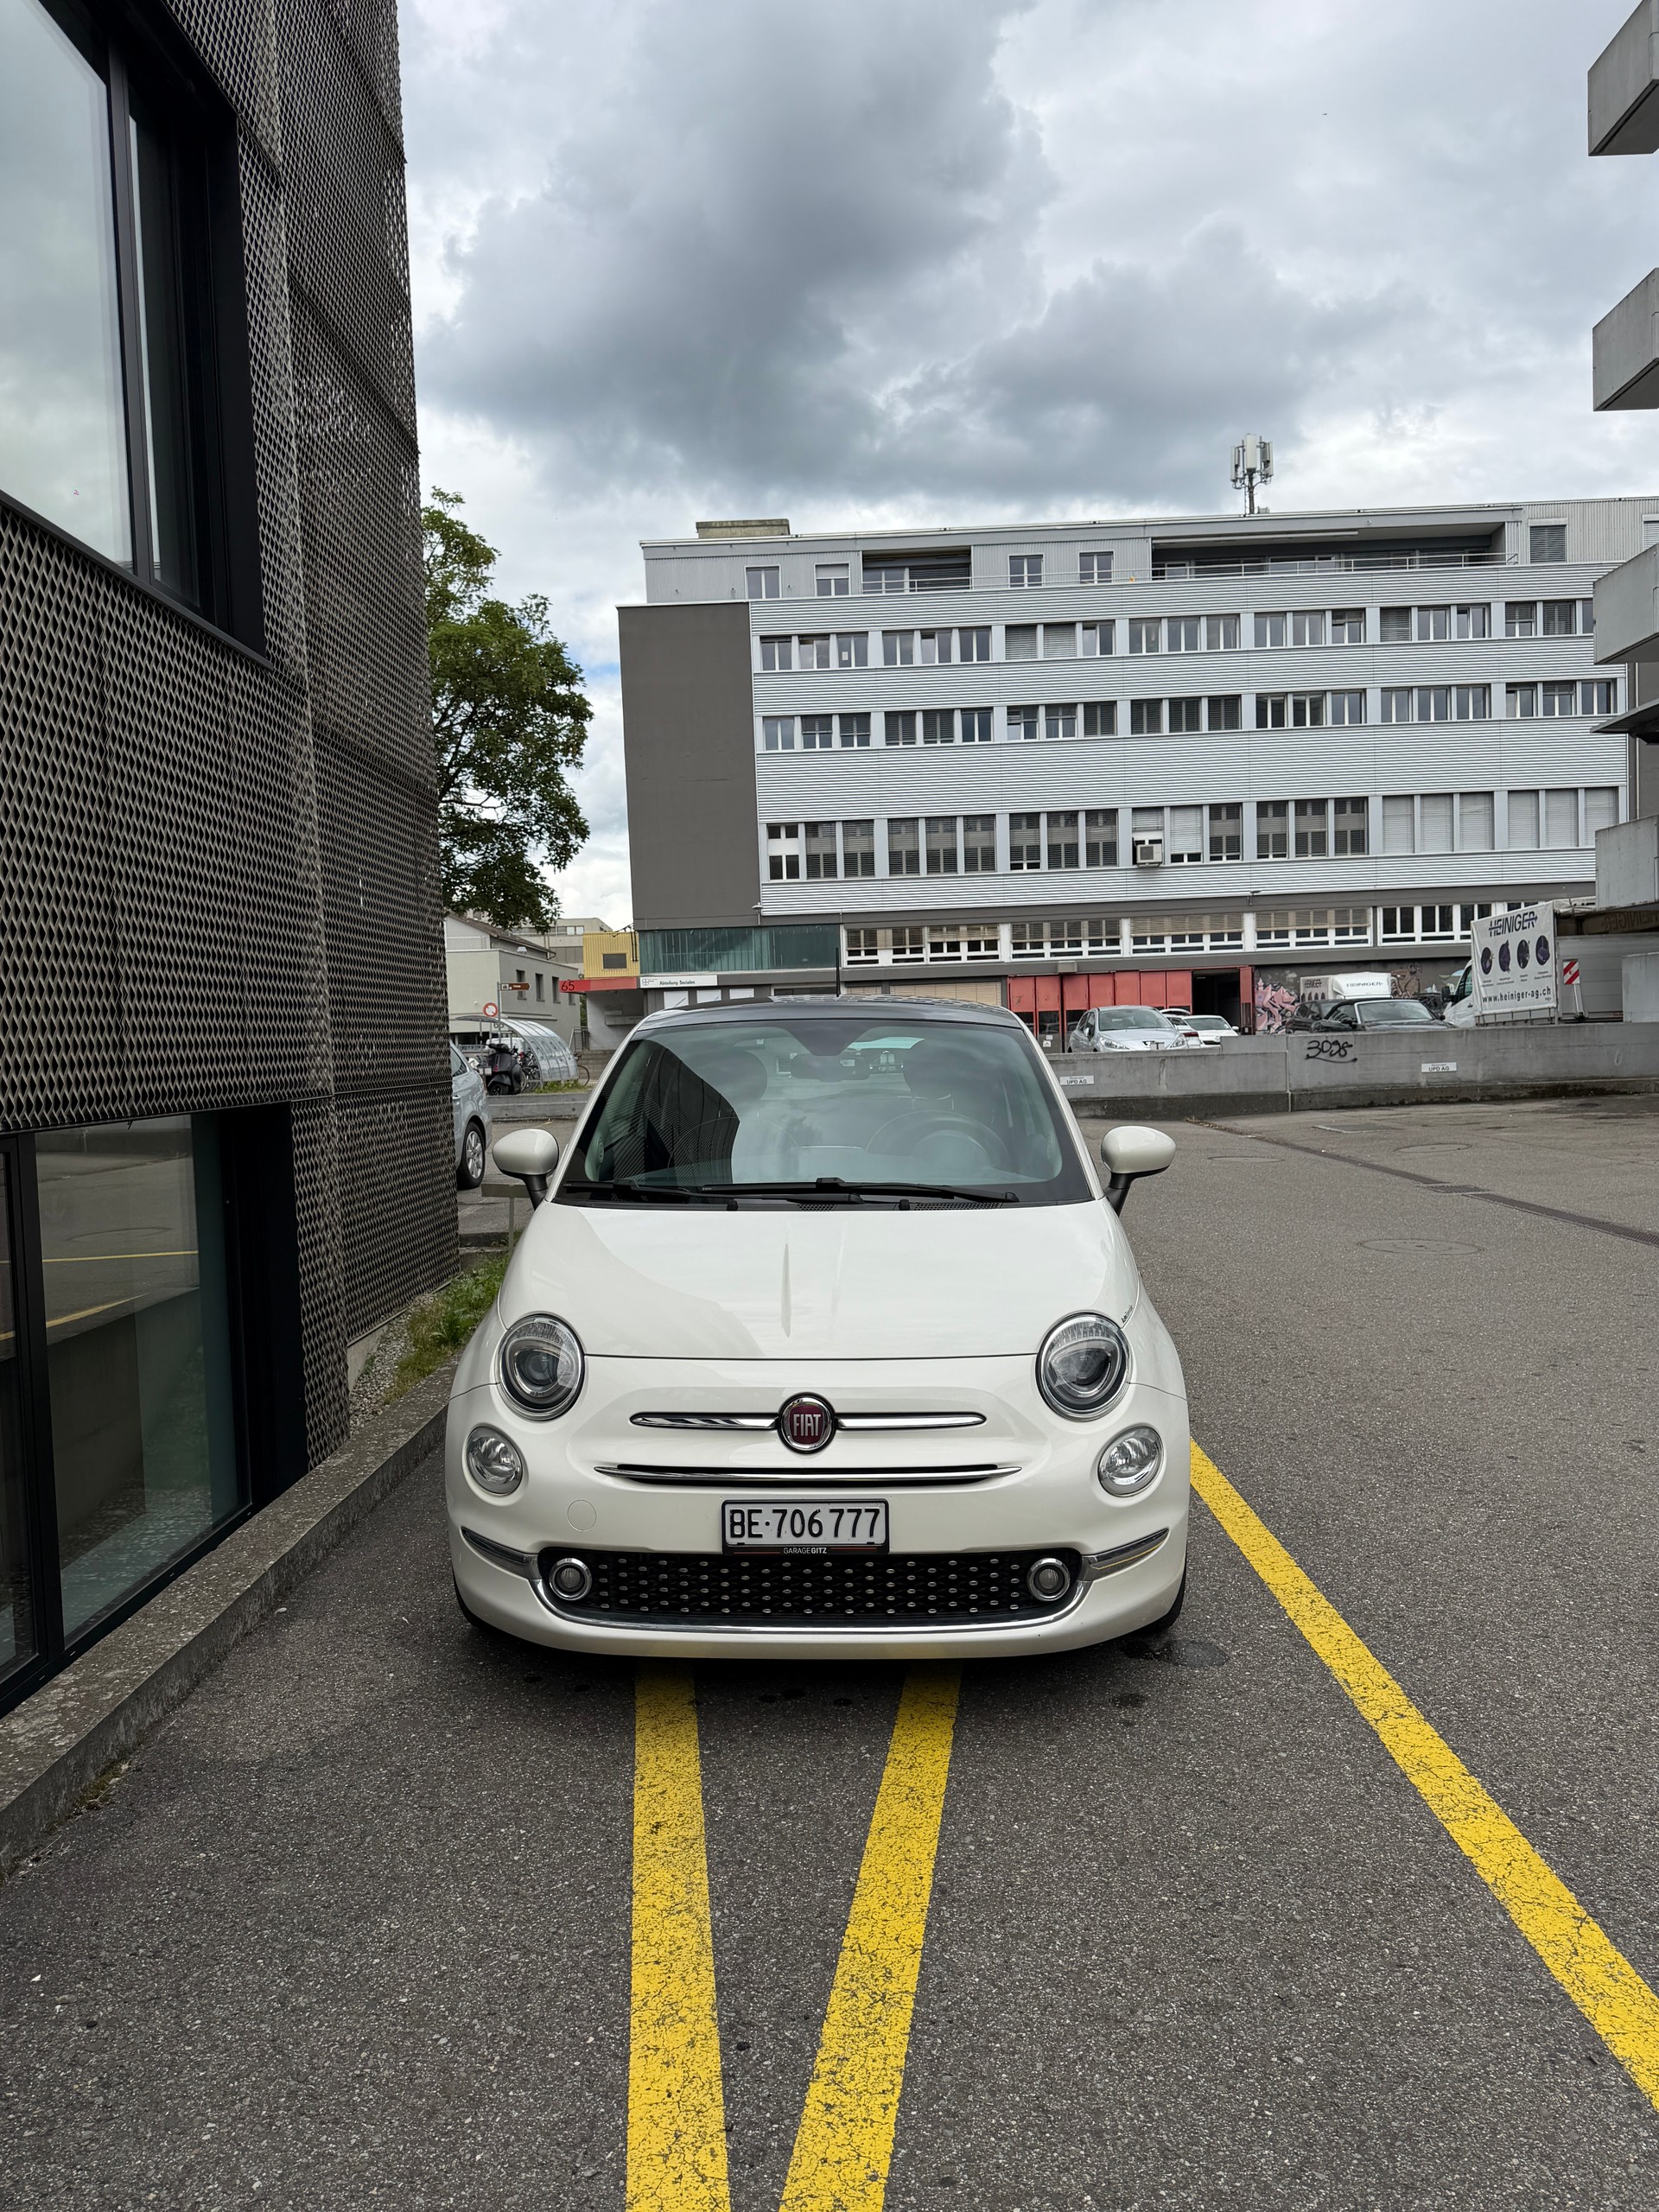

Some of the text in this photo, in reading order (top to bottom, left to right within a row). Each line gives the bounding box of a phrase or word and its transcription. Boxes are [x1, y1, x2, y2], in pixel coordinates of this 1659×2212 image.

[1489, 911, 1537, 937] HEINIGER
[561, 981, 575, 991] 65
[1482, 986, 1551, 1003] www.heiniger-ag.ch
[793, 1414, 821, 1436] FIAT
